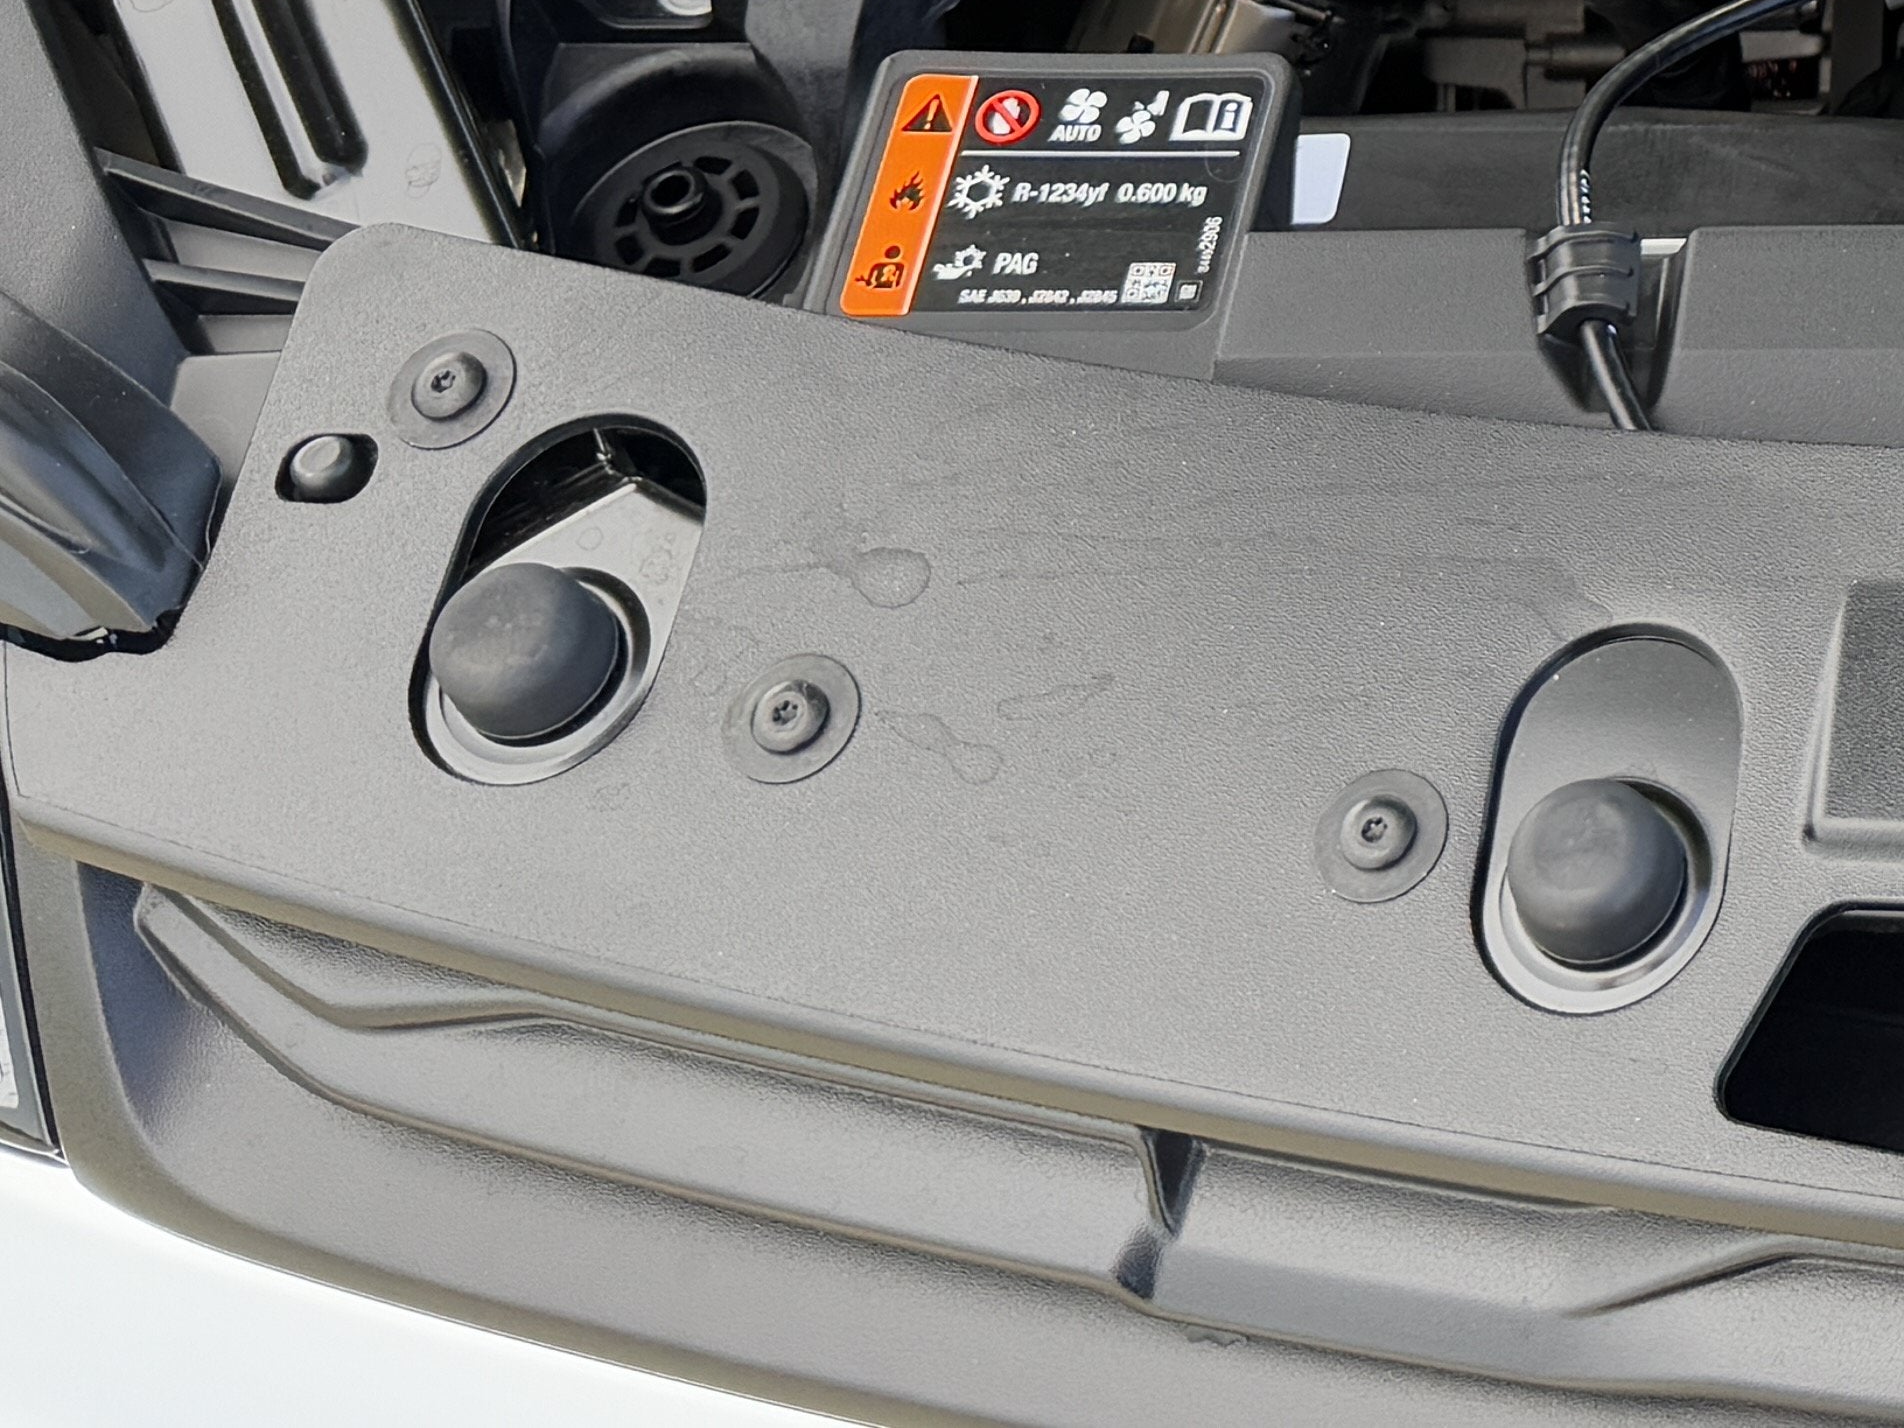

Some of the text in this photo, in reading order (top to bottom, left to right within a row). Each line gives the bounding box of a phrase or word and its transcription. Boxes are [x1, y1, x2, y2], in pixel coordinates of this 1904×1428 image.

[1048, 124, 1101, 142] AUTO
[1012, 181, 1207, 207] R-1234yf 0.600 kg
[993, 251, 1039, 275] PAG
[957, 289, 987, 303] SAE
